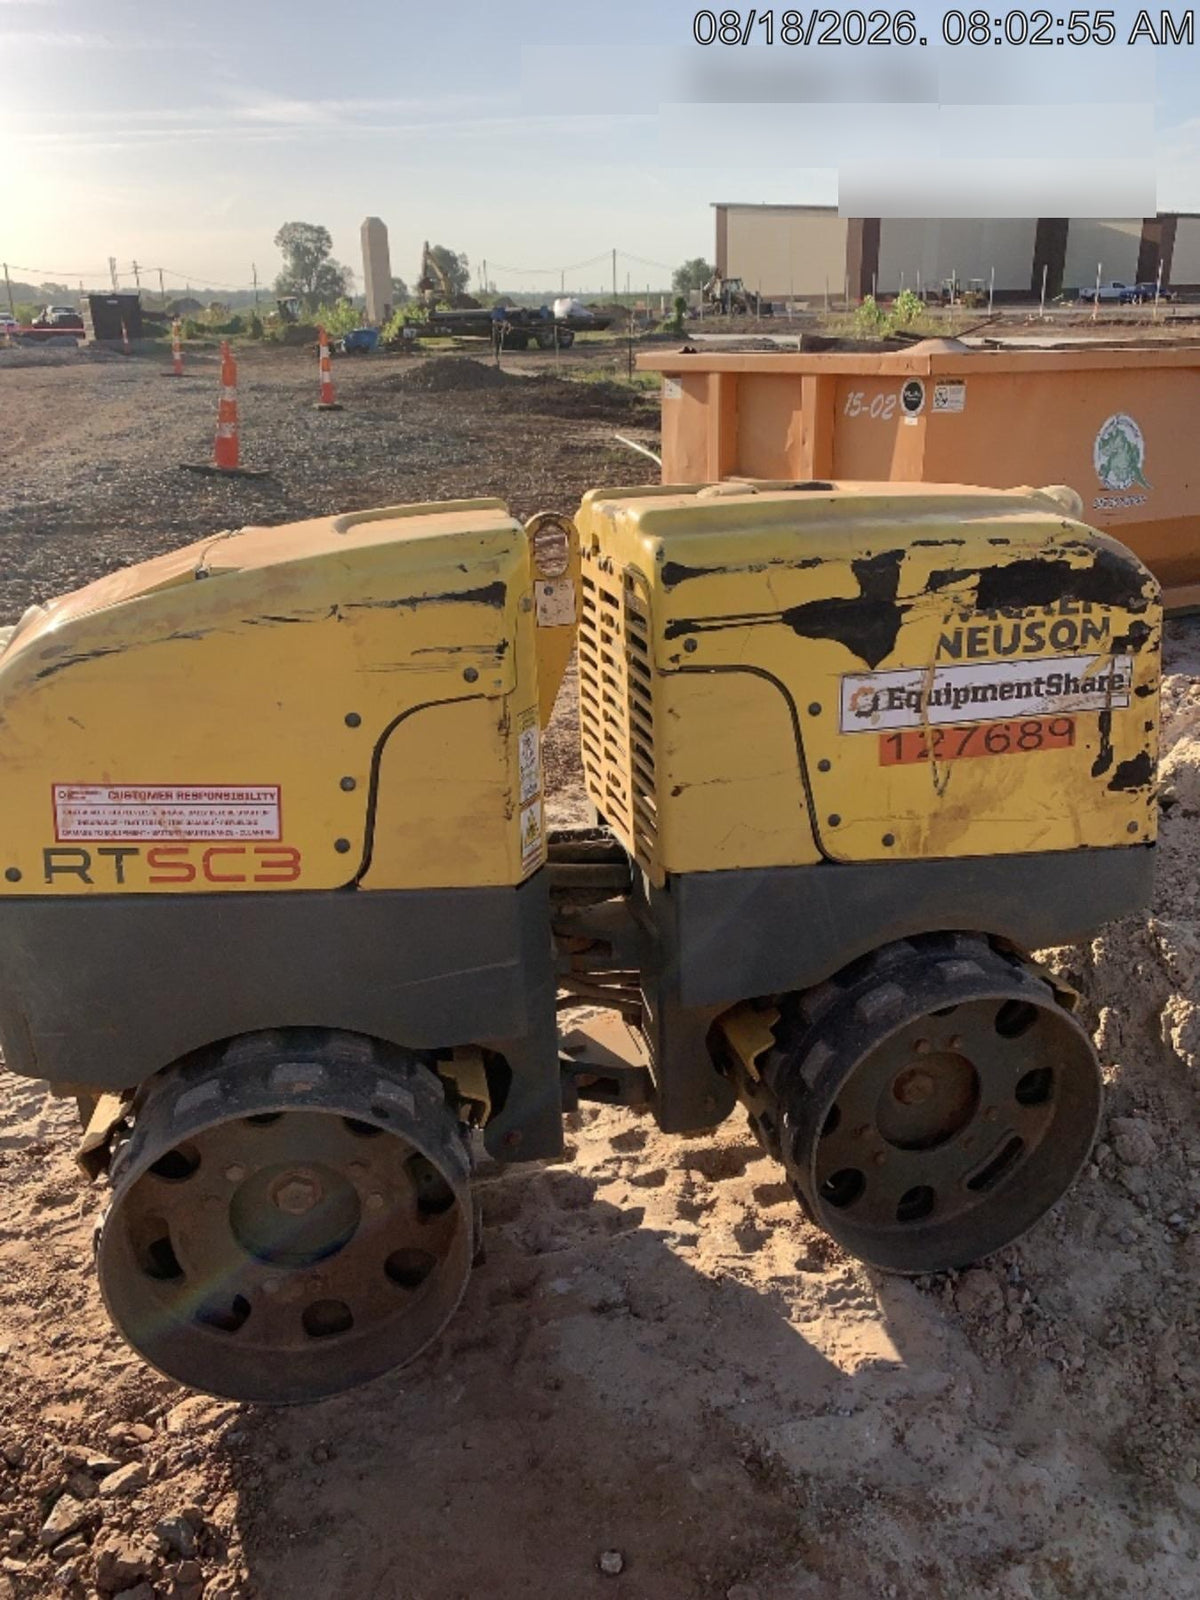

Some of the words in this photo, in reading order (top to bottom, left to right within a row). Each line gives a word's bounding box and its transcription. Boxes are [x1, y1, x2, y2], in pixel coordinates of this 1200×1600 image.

[843, 391, 897, 420] 15-02
[935, 616, 1110, 659] NEUSON
[887, 672, 1124, 713] EquipmentShare
[886, 717, 1075, 761] 127689
[107, 790, 174, 801] CUSTOMER
[176, 790, 277, 801] RESPONSIBILITY
